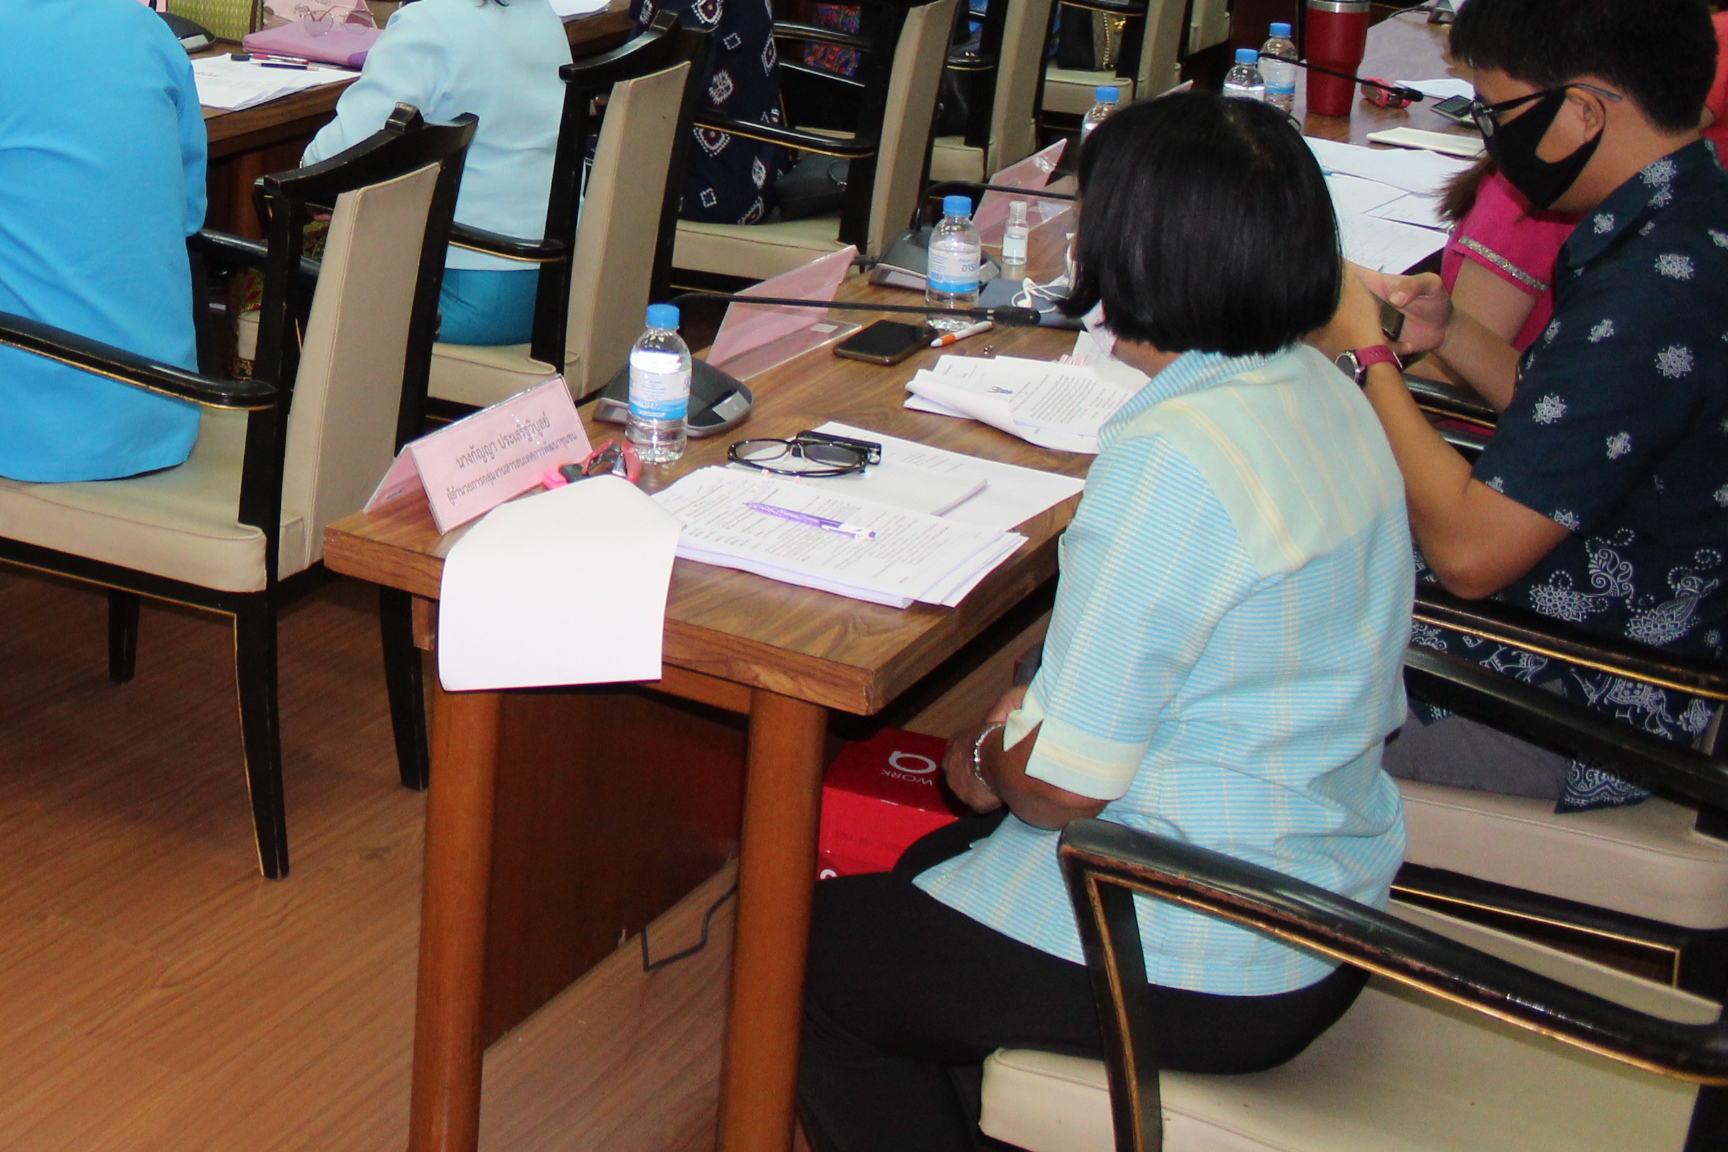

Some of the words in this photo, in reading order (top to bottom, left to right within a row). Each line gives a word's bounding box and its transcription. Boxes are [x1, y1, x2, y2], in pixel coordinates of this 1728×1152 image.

[456, 440, 497, 470] นางกัญญา
[879, 768, 933, 787] WORK
